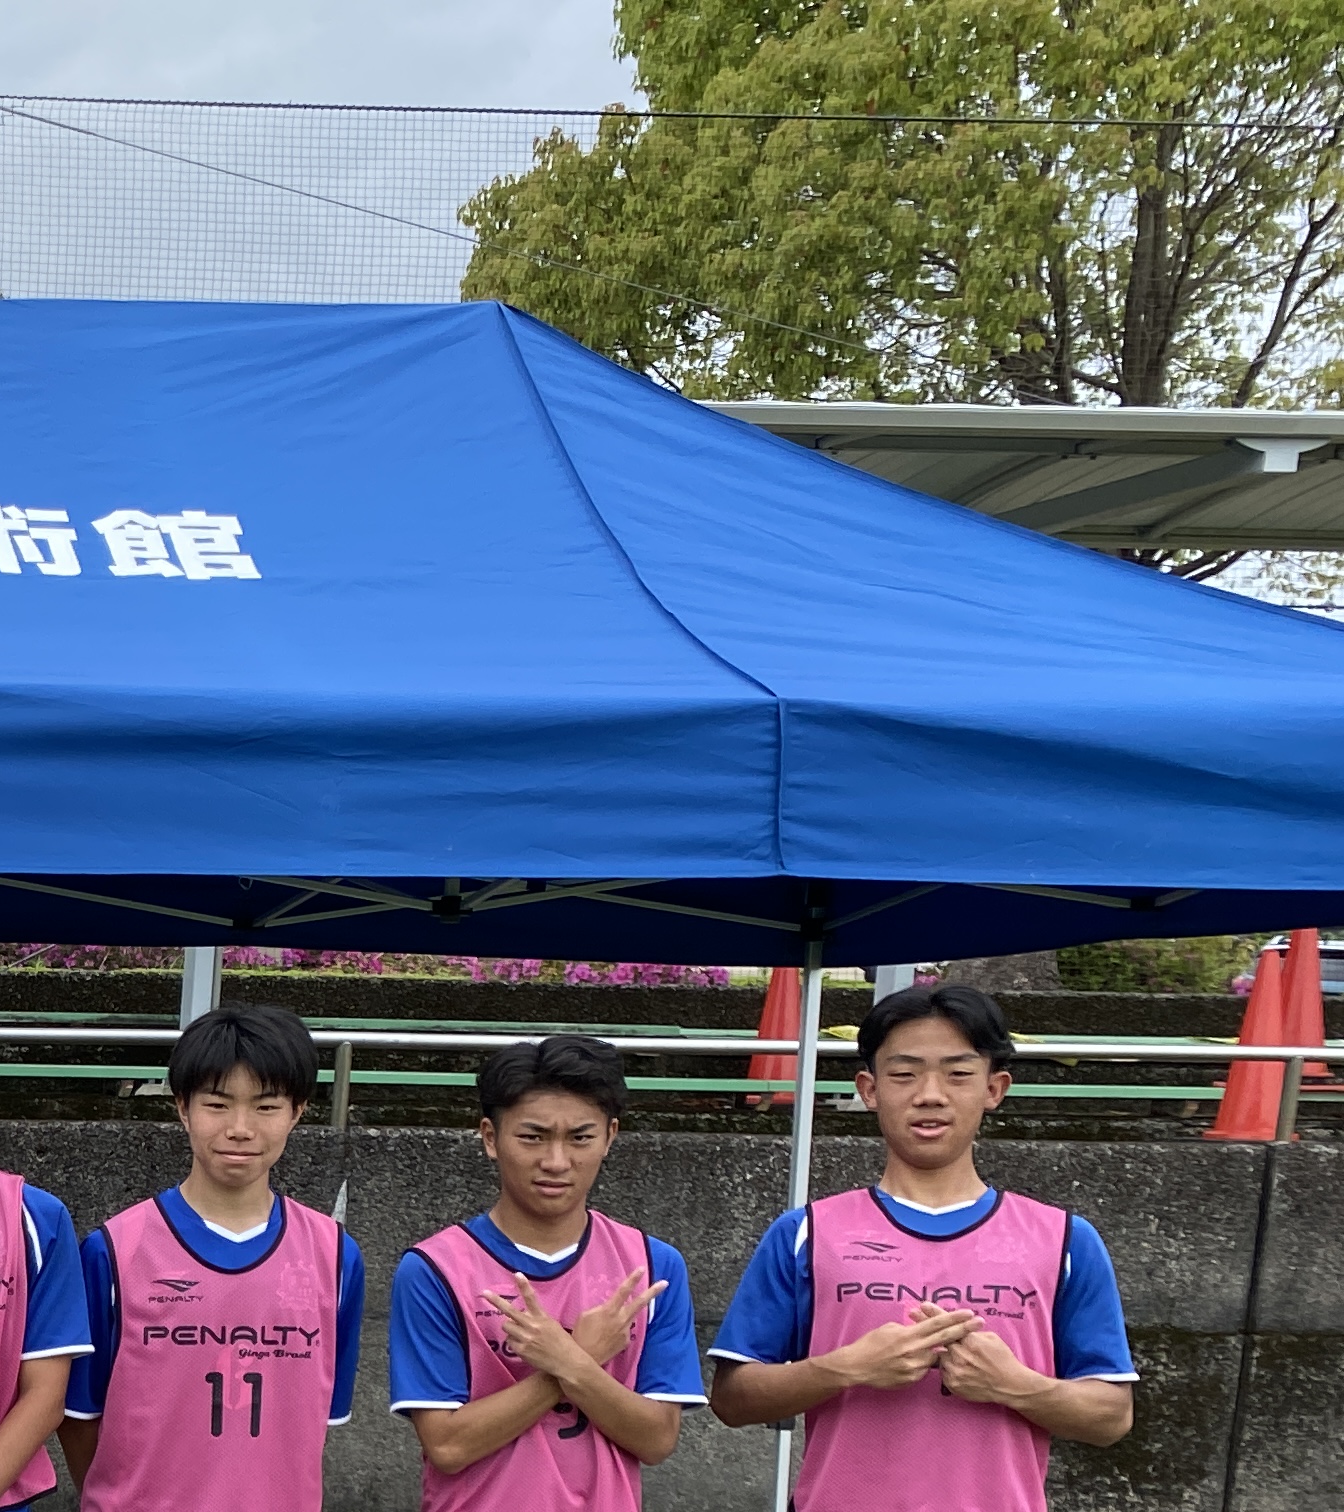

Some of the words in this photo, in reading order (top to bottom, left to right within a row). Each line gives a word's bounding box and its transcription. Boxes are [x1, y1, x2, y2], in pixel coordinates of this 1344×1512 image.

[842, 1254, 904, 1263] PENALTY
[148, 1295, 204, 1304] PENALTY
[836, 1281, 1038, 1307] PENALTY
[143, 1324, 321, 1347] PENALTY
[205, 1371, 263, 1438] 11
